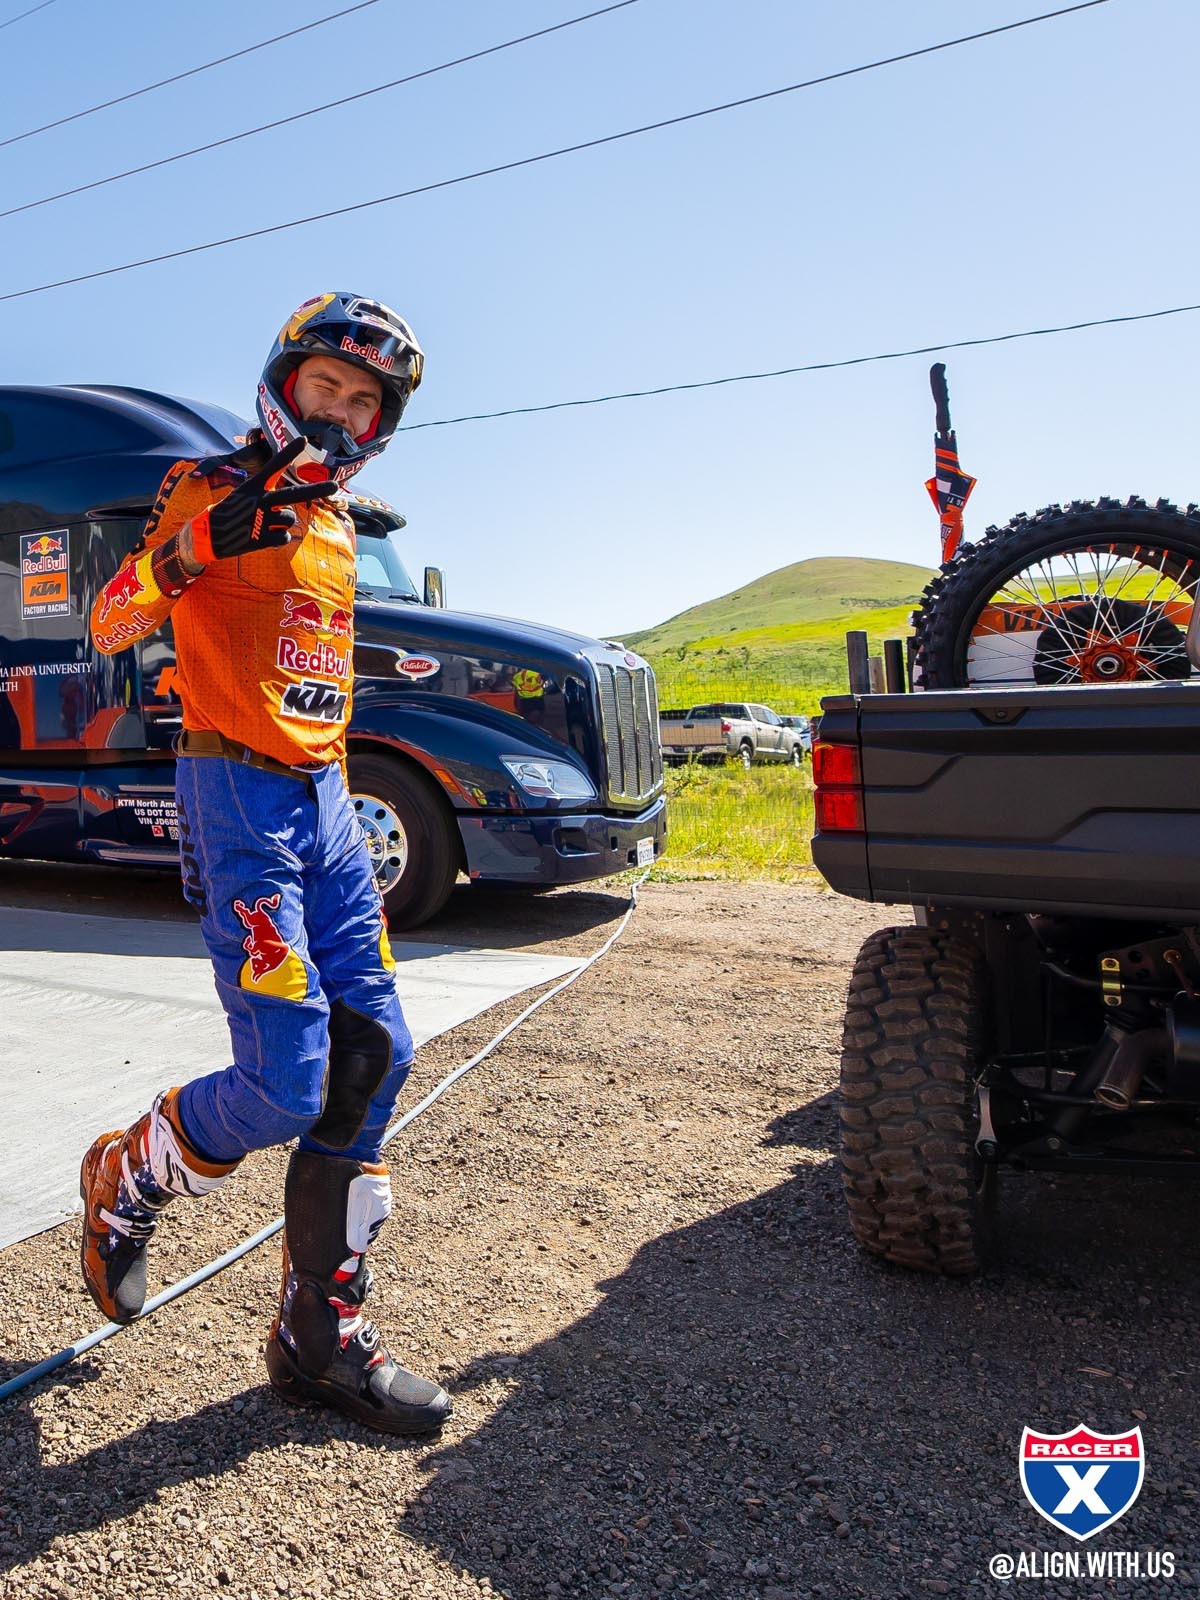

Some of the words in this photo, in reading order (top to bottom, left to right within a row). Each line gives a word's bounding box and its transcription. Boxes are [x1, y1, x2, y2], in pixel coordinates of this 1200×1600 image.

[251, 508, 264, 540] THOR
[29, 580, 61, 597] KTM
[23, 605, 46, 615] FACTORY
[47, 603, 68, 613] RACING
[1003, 608, 1058, 631] VIA
[10, 665, 37, 677] LINDA
[38, 662, 93, 676] UNIVERSITY
[280, 677, 348, 724] KTM
[117, 799, 135, 807] KTM
[136, 800, 158, 808] North
[159, 800, 177, 808] Ame
[134, 808, 146, 816] US
[147, 809, 163, 817] DOT
[138, 817, 153, 825] VIN
